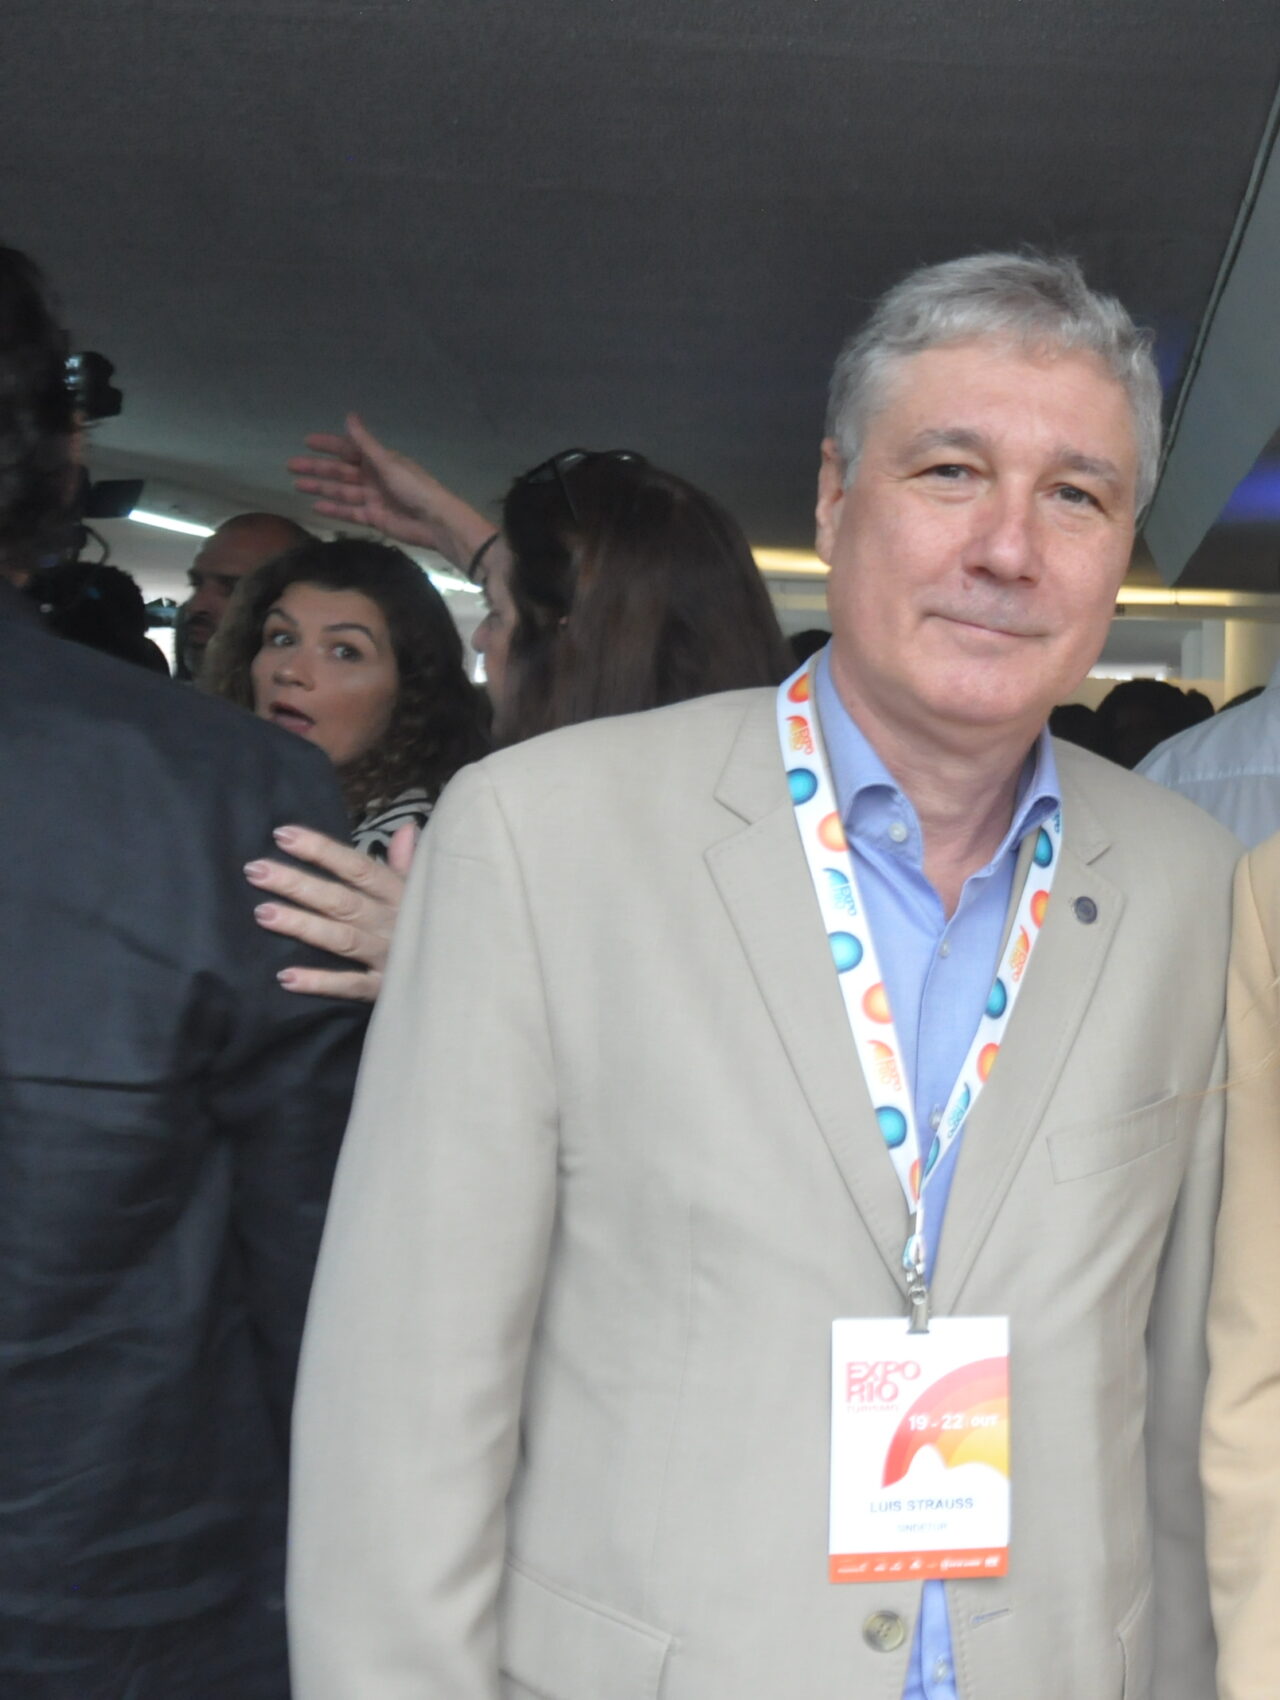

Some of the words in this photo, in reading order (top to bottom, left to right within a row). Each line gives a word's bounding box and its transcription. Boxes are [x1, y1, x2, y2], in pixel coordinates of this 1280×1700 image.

[846, 1360, 921, 1382] EXPO
[846, 1381, 899, 1403] RIO
[908, 1413, 928, 1431] 19
[941, 1413, 963, 1430] 22
[869, 1500, 902, 1513] LUIS
[906, 1497, 974, 1511] STRAUSS
